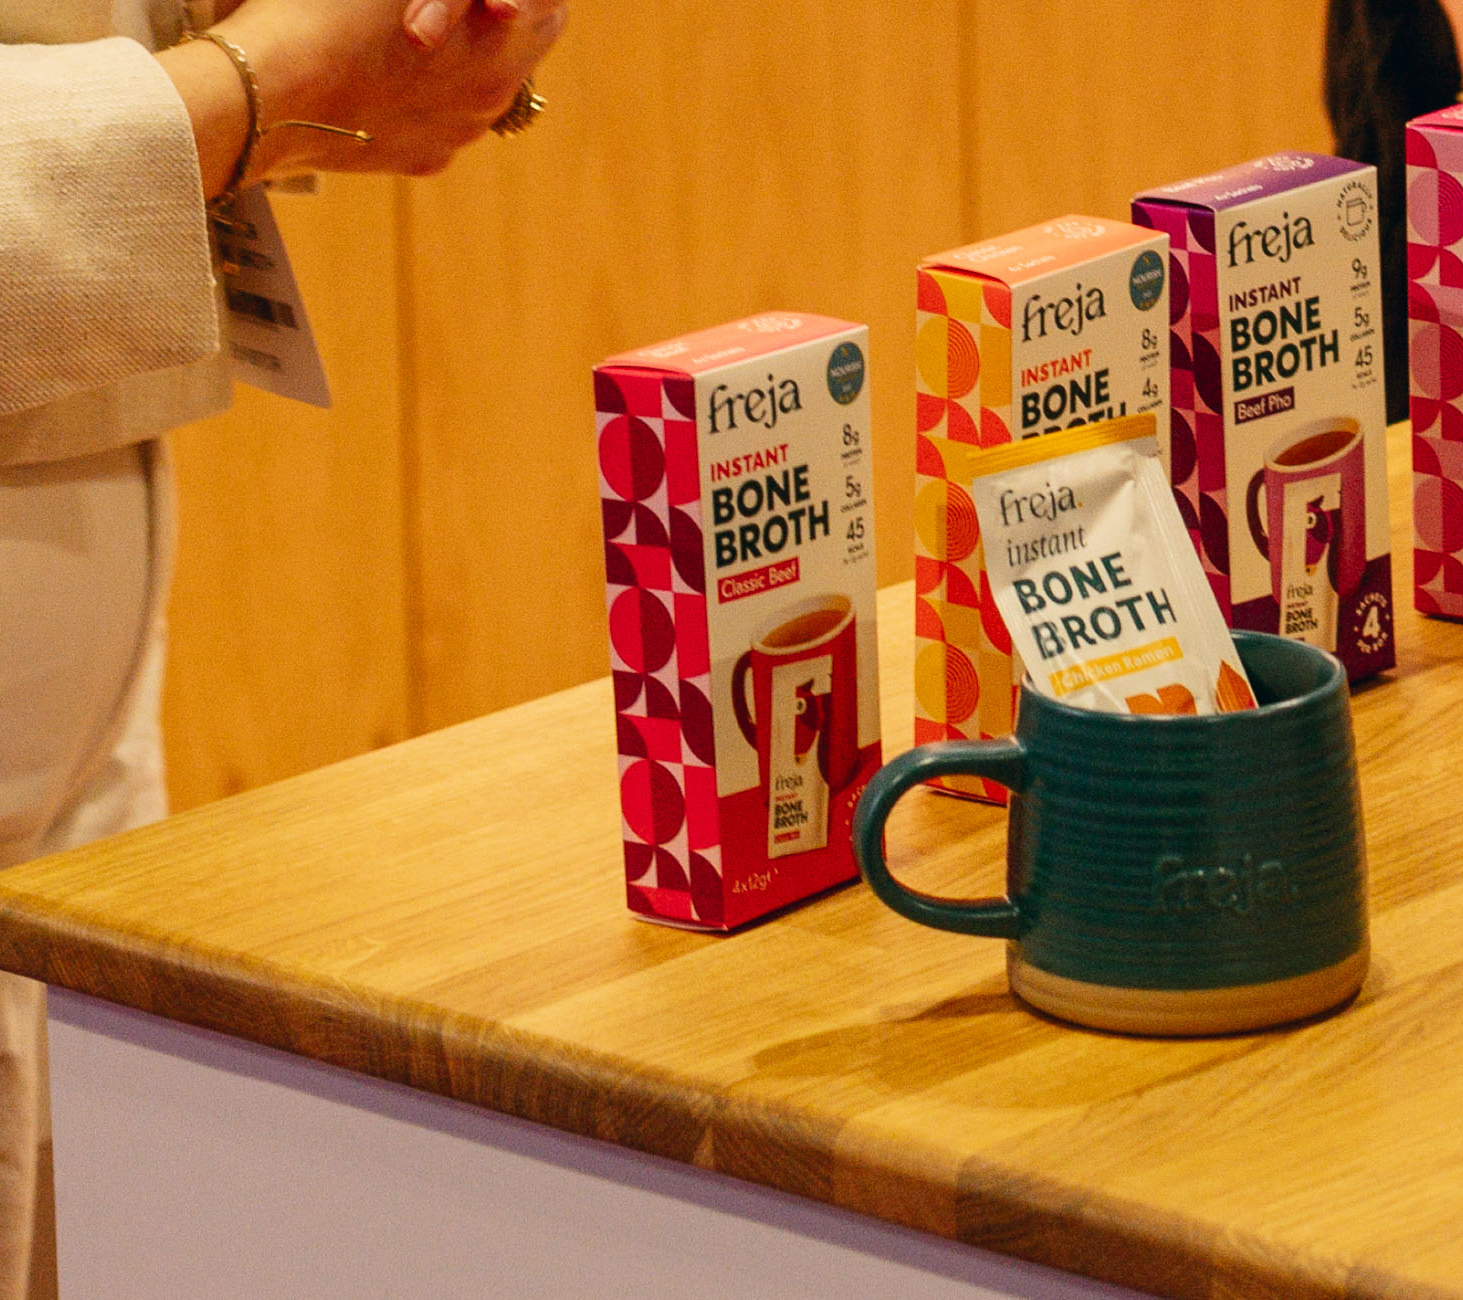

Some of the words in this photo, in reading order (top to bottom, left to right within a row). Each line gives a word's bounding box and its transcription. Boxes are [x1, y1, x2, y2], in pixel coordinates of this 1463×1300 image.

[1228, 211, 1315, 268] freja
[1022, 283, 1106, 342] freja
[1229, 277, 1301, 312] INSTANT
[1231, 296, 1321, 352] BONE
[1354, 307, 1370, 327] 5g
[1021, 349, 1092, 387] INSTANT
[1232, 329, 1340, 392] BROTH
[1355, 345, 1373, 366] 45
[709, 374, 802, 433] freja
[1022, 368, 1109, 429] BONE
[1237, 400, 1266, 421] Beef
[1269, 392, 1292, 411] Pho
[842, 423, 859, 447] 8g
[710, 444, 788, 482] INSTANT
[712, 464, 811, 526] BONE
[845, 475, 861, 499] 5g
[715, 500, 830, 568] BROTH
[846, 517, 865, 542] 45
[1007, 525, 1087, 567] instant
[720, 574, 766, 599] Classic
[768, 563, 798, 587] Beef
[1012, 552, 1132, 615] BONE
[1031, 588, 1177, 660] BROTH
[1362, 605, 1382, 640] 4
[1124, 644, 1175, 669] Ramen
[774, 802, 803, 817] BONE
[774, 812, 808, 829] BROTH
